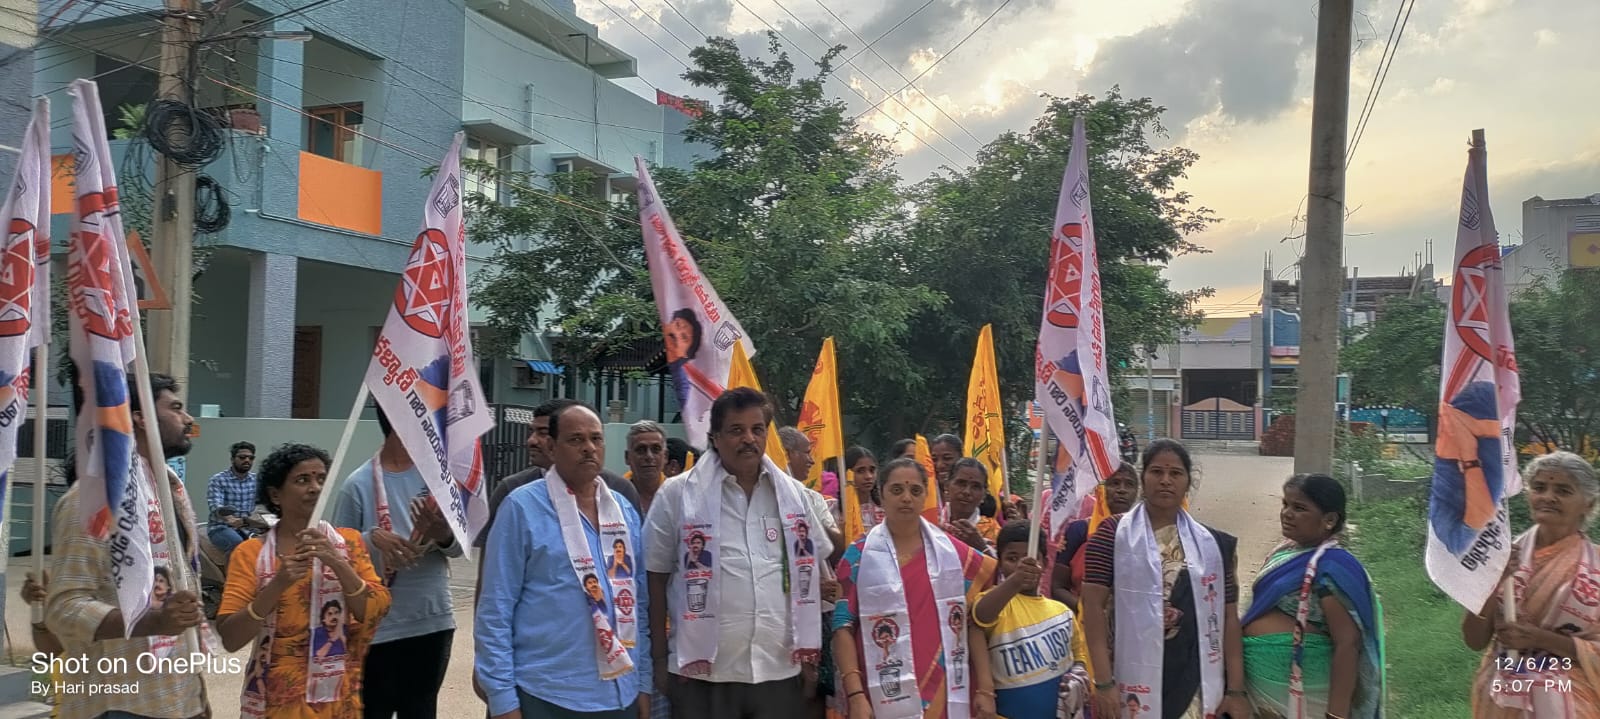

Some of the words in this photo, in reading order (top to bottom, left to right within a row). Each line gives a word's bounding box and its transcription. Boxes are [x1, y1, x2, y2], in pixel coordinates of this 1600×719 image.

[406, 388, 428, 418] గారి
[999, 640, 1049, 677] TEAM
[1041, 624, 1072, 661] USP
